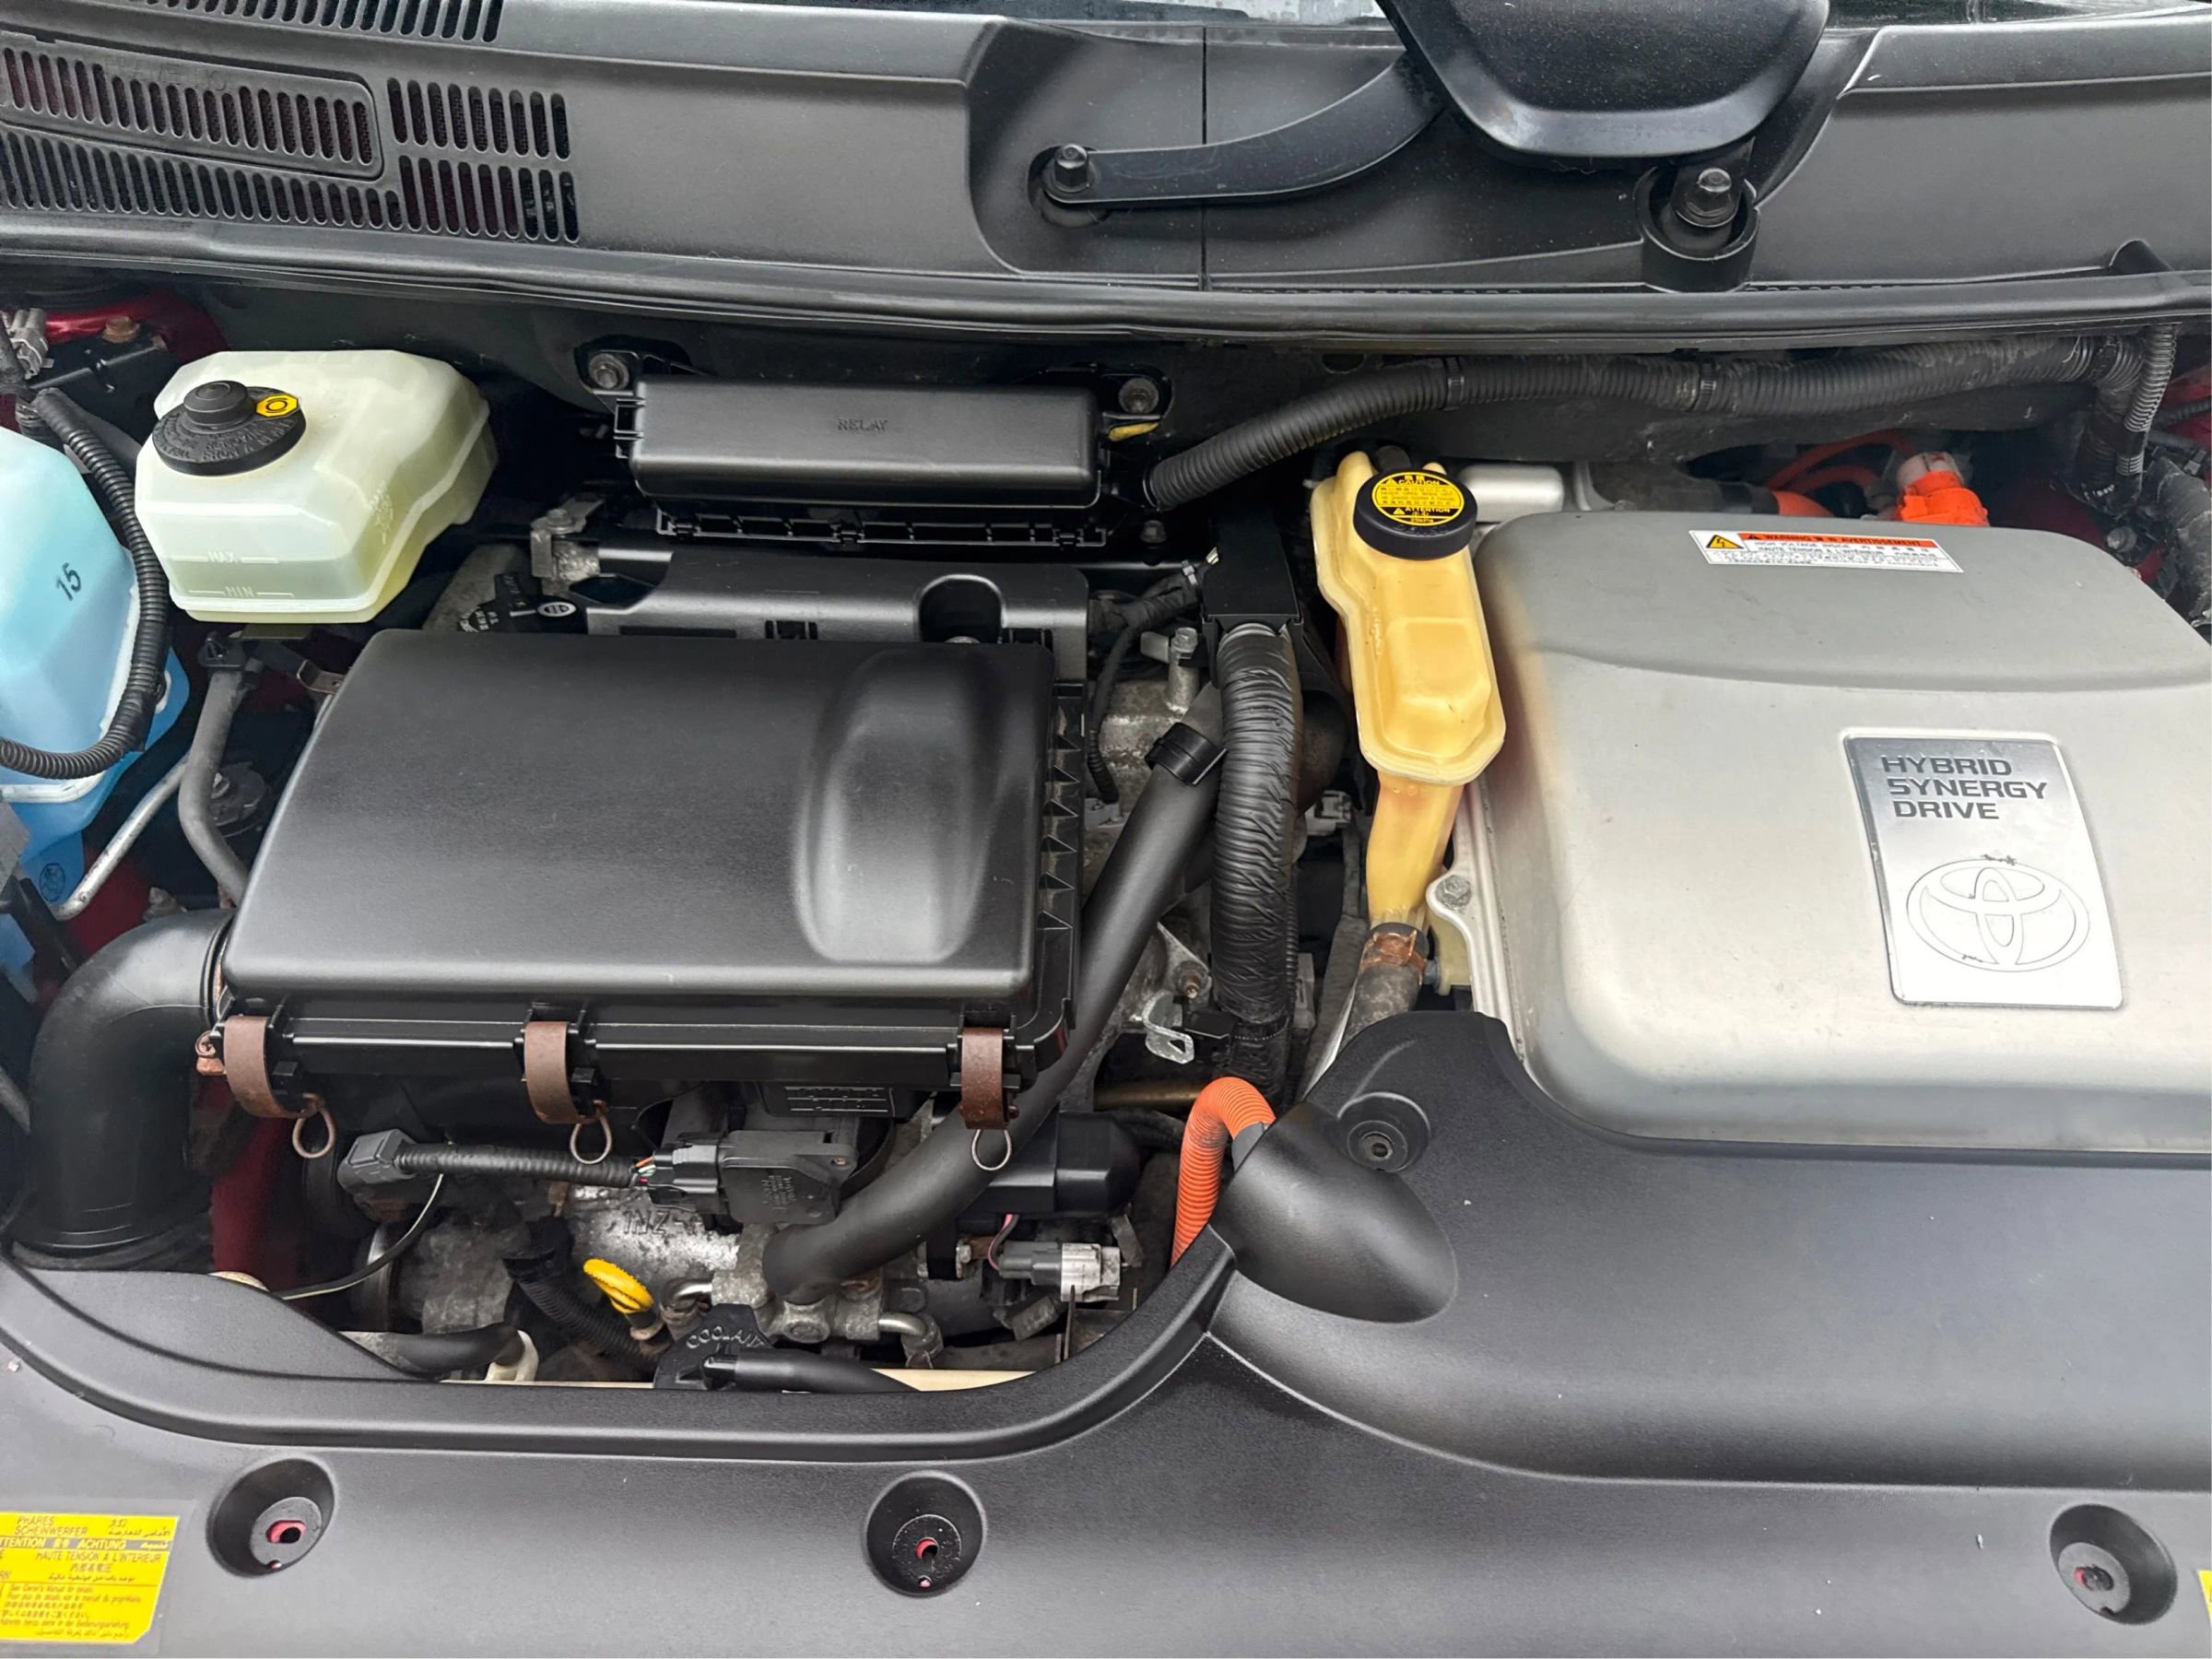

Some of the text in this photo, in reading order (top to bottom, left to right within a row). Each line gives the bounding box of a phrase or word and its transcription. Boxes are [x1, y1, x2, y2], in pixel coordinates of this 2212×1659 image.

[837, 418, 888, 431] RELAY
[207, 550, 240, 563] MAX
[55, 562, 82, 601] 15
[224, 586, 254, 597] MIN
[1881, 755, 2013, 776] HYBRID
[1888, 779, 2048, 800] SYNERGY
[1894, 801, 2000, 819] DRIVE
[17, 1515, 56, 1526] PHARES
[15, 1525, 88, 1536] SCHEINWERFER
[76, 1538, 127, 1550] ACHTUNG
[35, 1550, 64, 1561] HAUTE
[66, 1550, 100, 1562] TENSION
